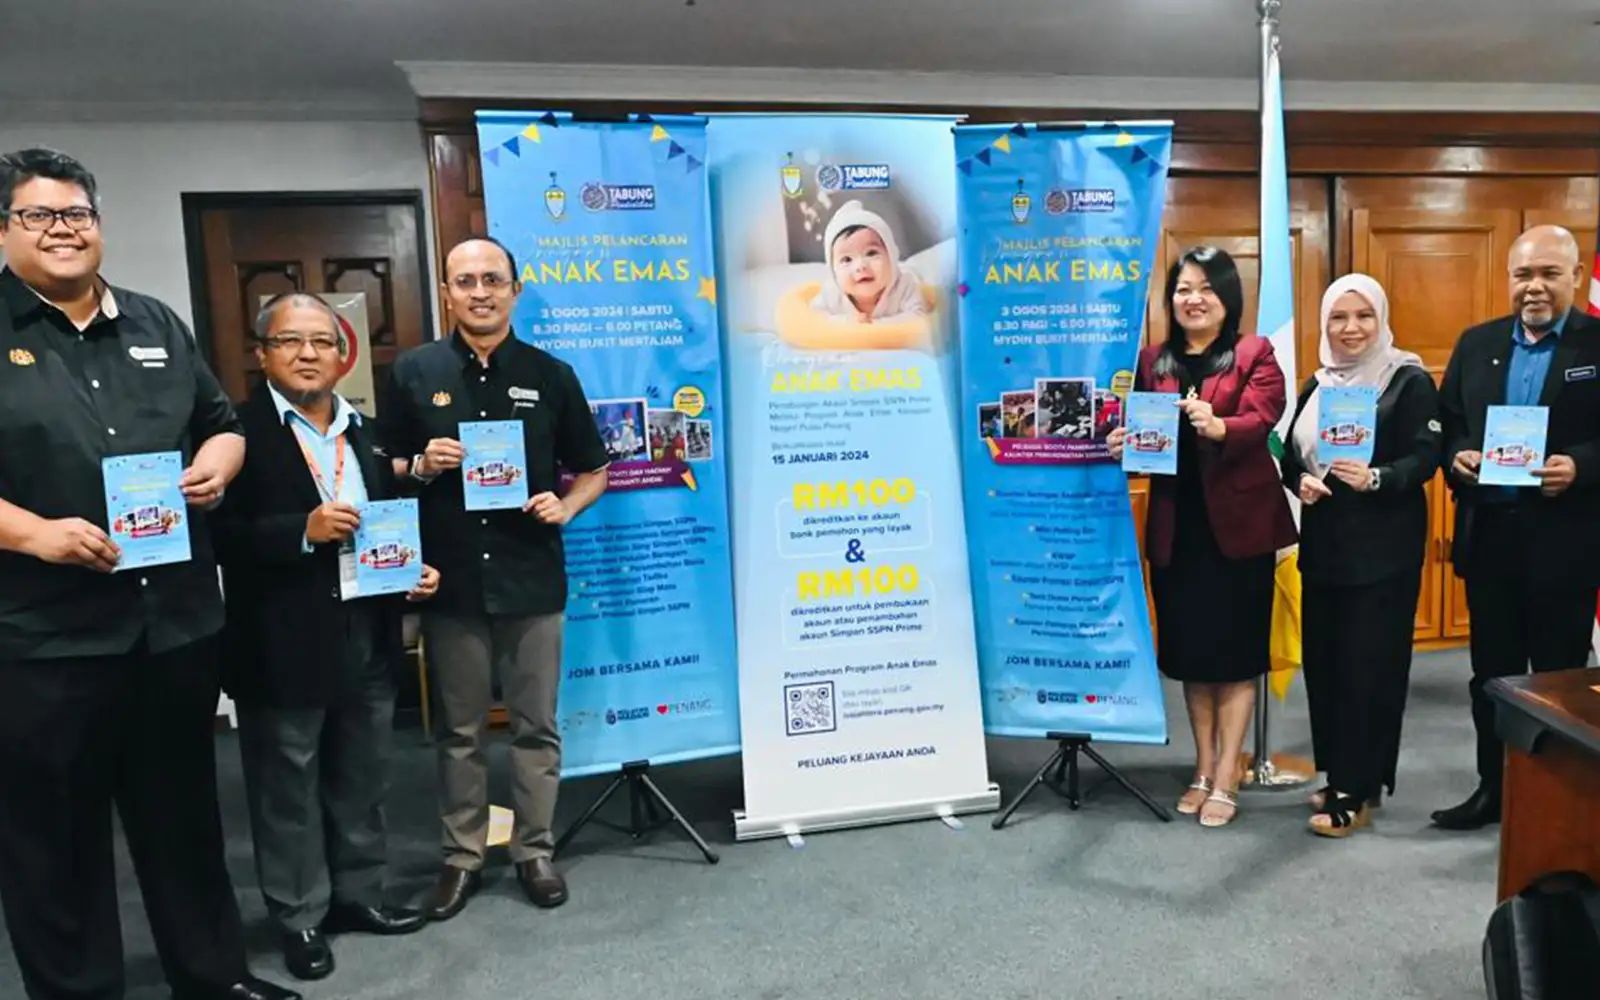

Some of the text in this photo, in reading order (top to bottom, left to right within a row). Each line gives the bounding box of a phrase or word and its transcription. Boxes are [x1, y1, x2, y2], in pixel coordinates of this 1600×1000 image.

[845, 166, 888, 179] TABUNG
[609, 187, 654, 200] TABUNG
[1072, 191, 1113, 203] TABUNG
[538, 234, 688, 248] MAJLIS PELANCARAN
[1003, 236, 1142, 250] MAJLIS PELANCARAN
[520, 259, 691, 285] ANAK EMAS
[985, 260, 1141, 284] ANAK EMAS
[552, 307, 590, 318] OGOS
[592, 306, 623, 317] 2024
[631, 305, 673, 316] SABTU
[1012, 305, 1047, 316] OGOS
[1087, 303, 1121, 314] SABTU
[563, 322, 592, 334] PAGI
[634, 319, 682, 331] PETANG
[1022, 320, 1048, 330] PAGI
[1088, 318, 1128, 329] PETANG
[579, 337, 616, 349] BUKIT
[619, 336, 684, 347] MERTAJAM
[993, 332, 1128, 345] MYDIN BUKIT MERTAJAM
[771, 367, 922, 393] ANAK EMAS
[772, 450, 869, 465] 15 JANUARI 2024
[793, 477, 915, 511] RM100
[803, 515, 855, 525] dikreditkan
[871, 512, 900, 521] akaun
[790, 531, 813, 539] bank
[816, 527, 860, 538] pemohon
[862, 526, 885, 536] yang
[845, 538, 865, 563] &
[797, 564, 919, 600] RM100
[791, 599, 929, 616] dikreditkan untuk pembukaan
[804, 612, 917, 628] akaun atau penambahan
[800, 623, 922, 641] akaun Simpan SSPN Prime
[568, 667, 595, 679] JOM
[600, 660, 660, 676] BERSAMA
[1006, 655, 1029, 665] JOM
[1034, 656, 1091, 669] BERSAMA
[669, 699, 712, 714] PENANG
[798, 746, 936, 768] PELUANG KEJAYAAN ANDA
